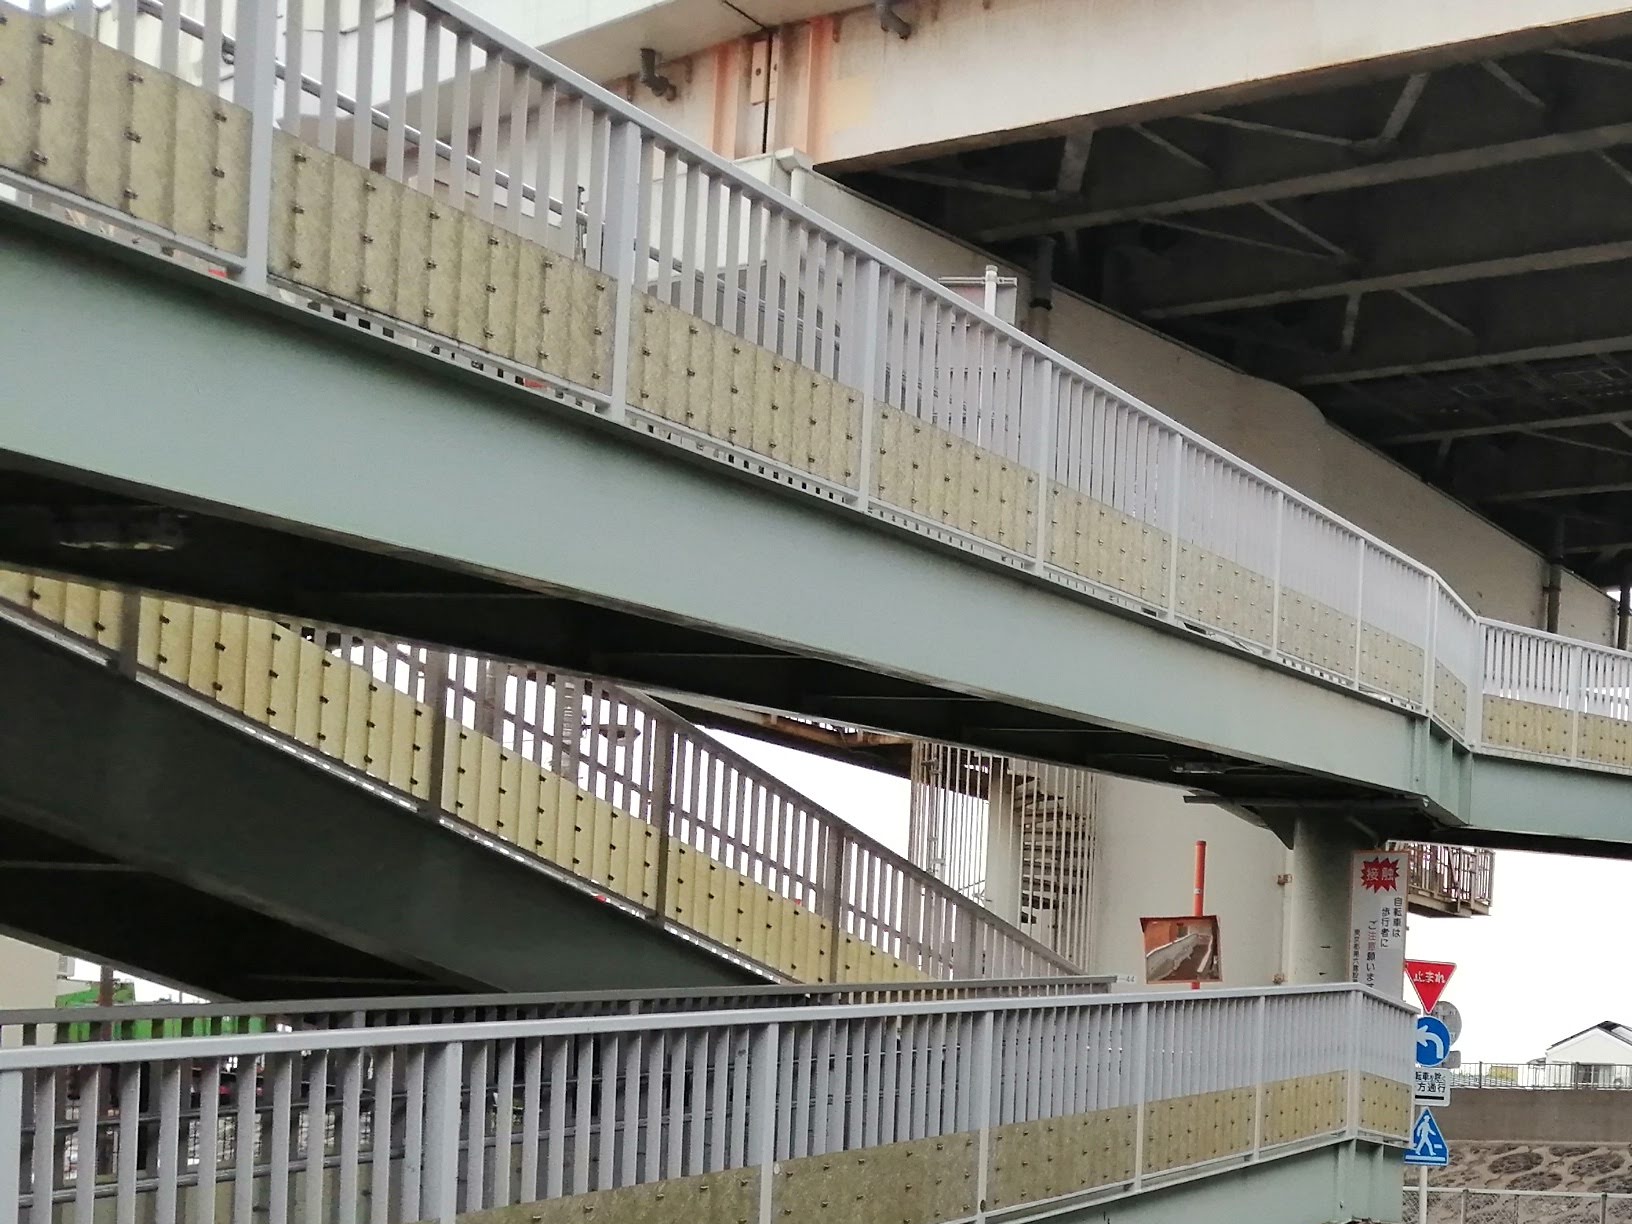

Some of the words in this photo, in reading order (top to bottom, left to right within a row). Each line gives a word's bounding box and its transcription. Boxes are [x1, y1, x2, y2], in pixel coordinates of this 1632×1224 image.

[1380, 907, 1390, 948] 歩行者に
[1392, 896, 1403, 938] 自転車は
[1413, 971, 1446, 983] 止まれ
